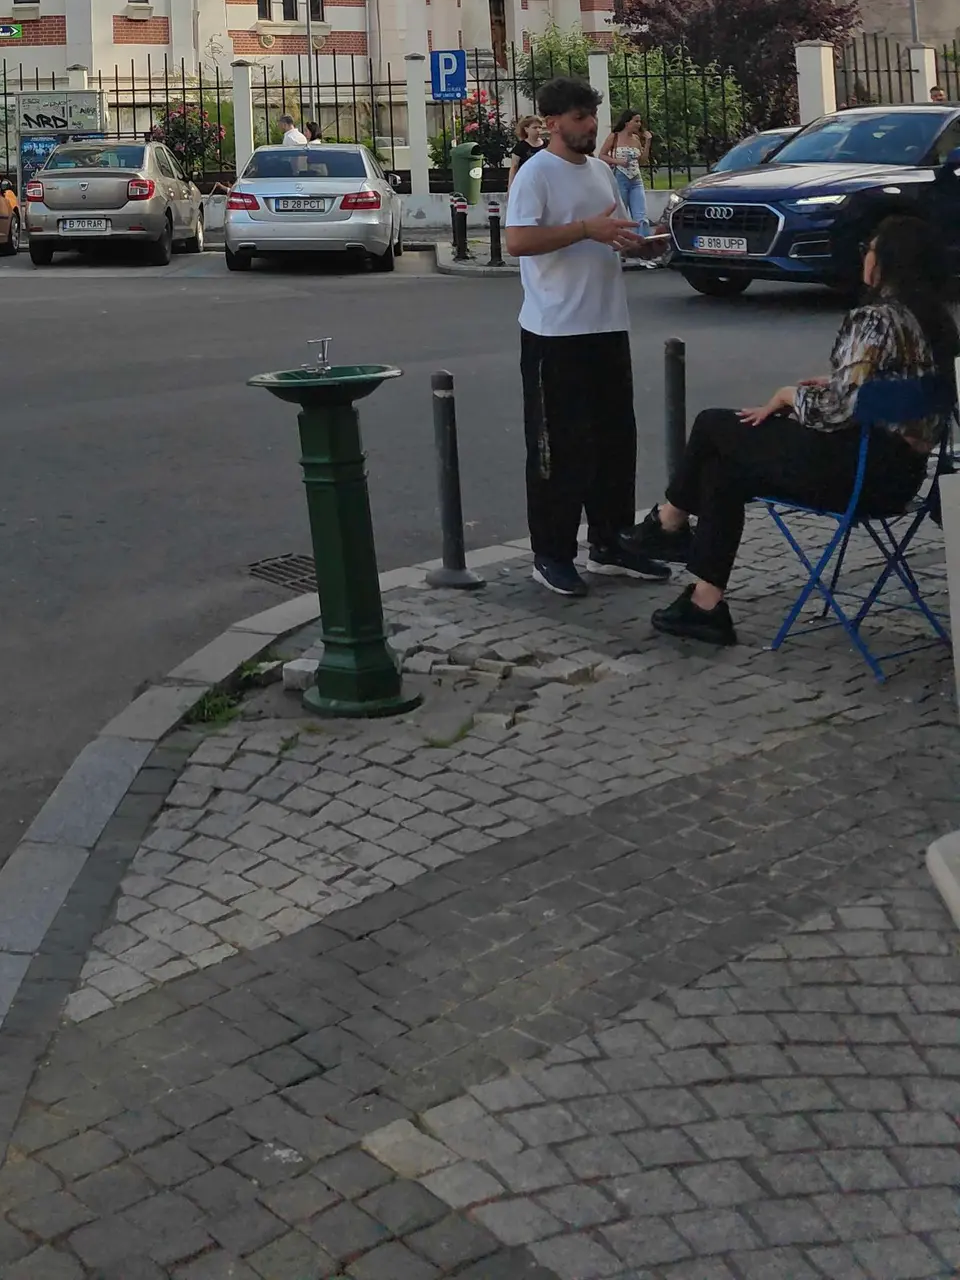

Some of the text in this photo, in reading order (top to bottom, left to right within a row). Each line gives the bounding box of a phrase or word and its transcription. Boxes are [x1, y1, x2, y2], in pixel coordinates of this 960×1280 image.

[439, 53, 457, 92] P
[282, 201, 321, 209] B 28 PCT
[699, 237, 744, 249] B 818 UPP
